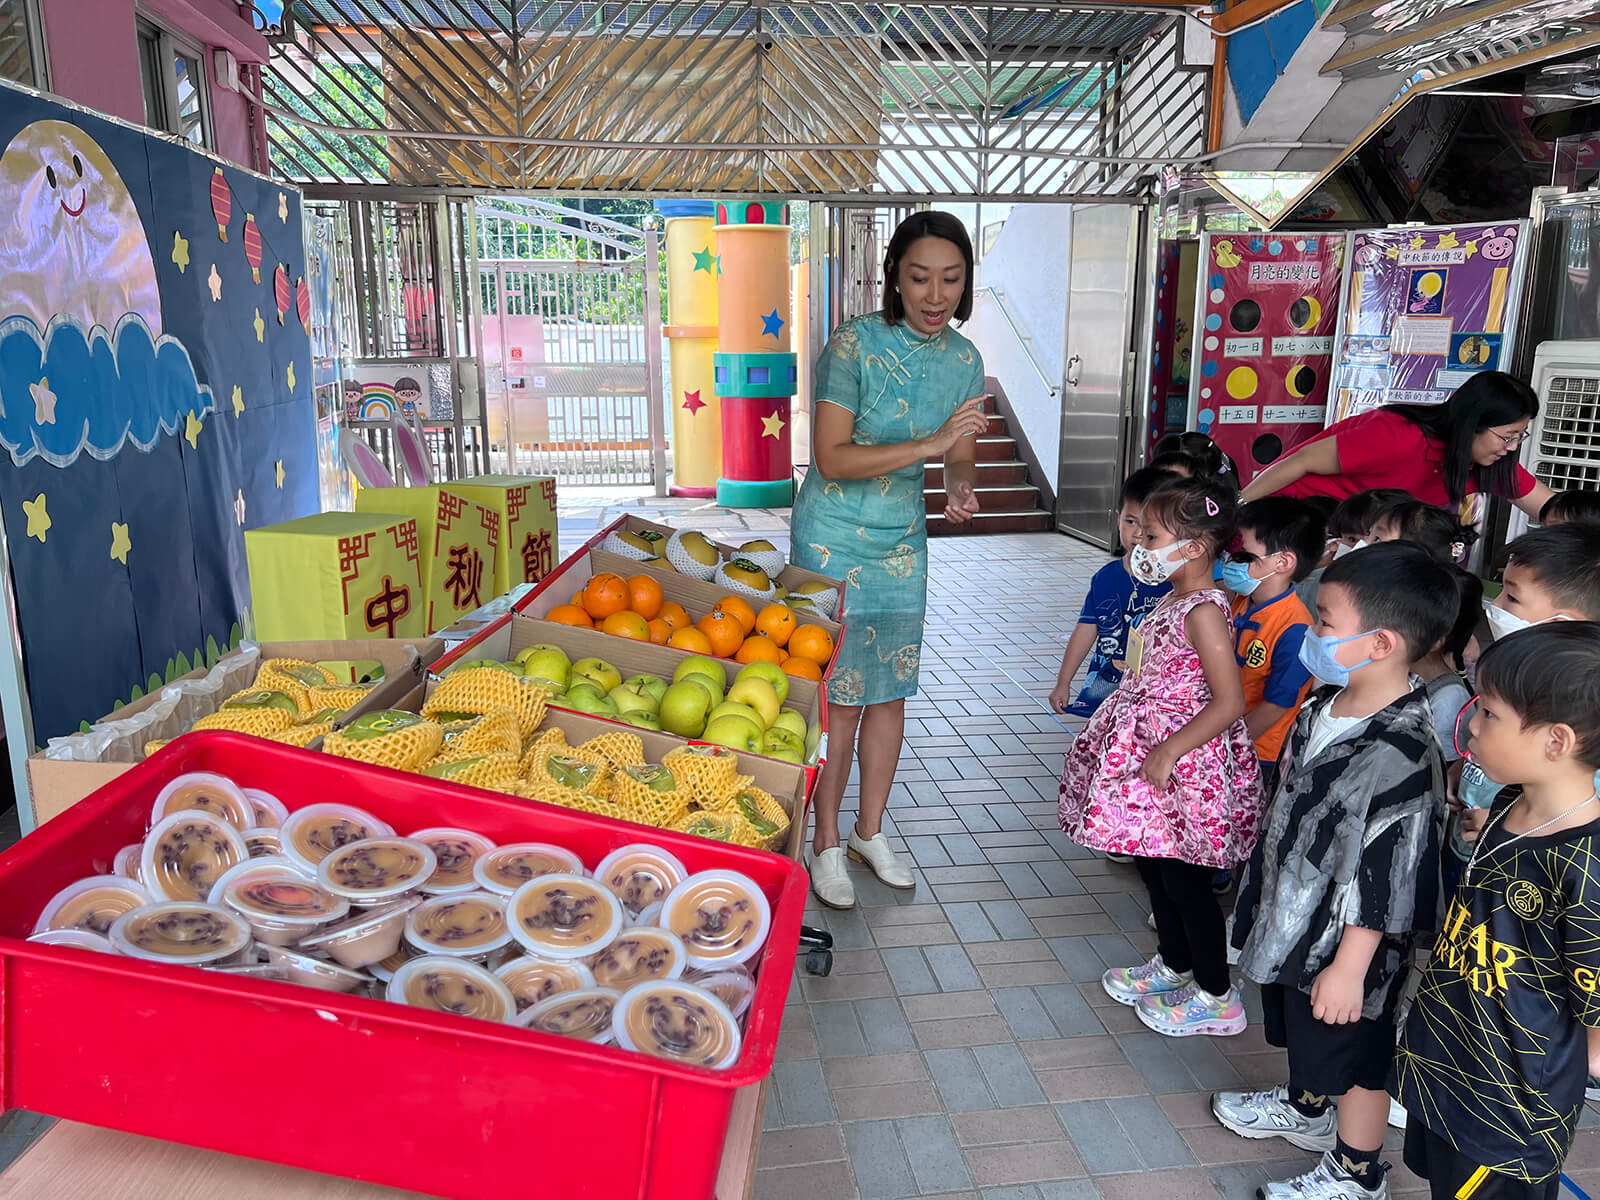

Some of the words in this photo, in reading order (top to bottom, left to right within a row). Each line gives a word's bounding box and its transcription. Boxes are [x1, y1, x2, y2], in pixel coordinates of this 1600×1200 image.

[1251, 264, 1320, 280] 月亮的變化
[1226, 342, 1260, 353] 初一日
[1221, 409, 1254, 420] 十五日
[444, 543, 484, 609] 秋
[1444, 894, 1516, 990] TAR
[1574, 967, 1600, 992] G
[1298, 1089, 1327, 1108] M
[1341, 1153, 1370, 1175] M
